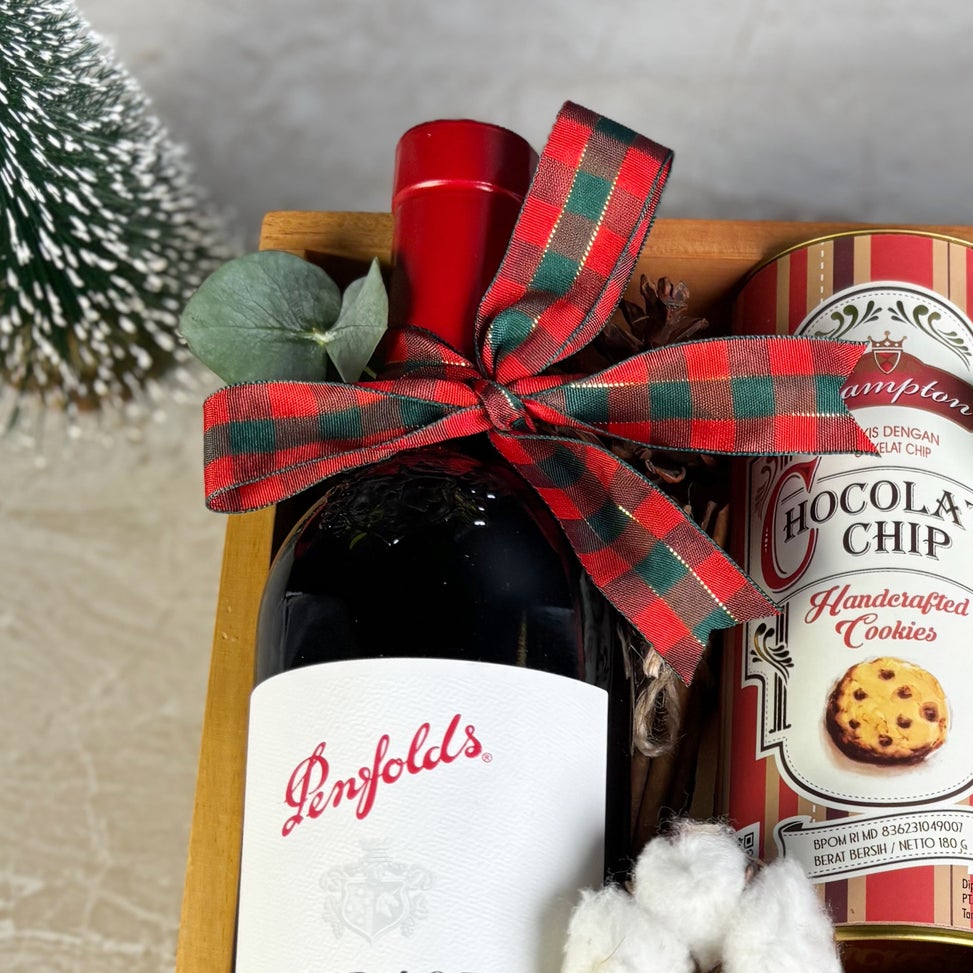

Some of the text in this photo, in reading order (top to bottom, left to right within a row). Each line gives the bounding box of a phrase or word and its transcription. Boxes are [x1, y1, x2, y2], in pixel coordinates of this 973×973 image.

[840, 377, 973, 417] ampton
[883, 425, 940, 446] DENGAN
[906, 443, 932, 458] CHIP
[842, 520, 954, 561] CHIP
[803, 583, 970, 625] Handcrafted
[834, 612, 938, 650] Cookies
[281, 713, 483, 837] Penfolds
[813, 820, 964, 850] BPOM RI MD 836231049007
[813, 836, 958, 867] BERAT BERSIH NETTO 180
